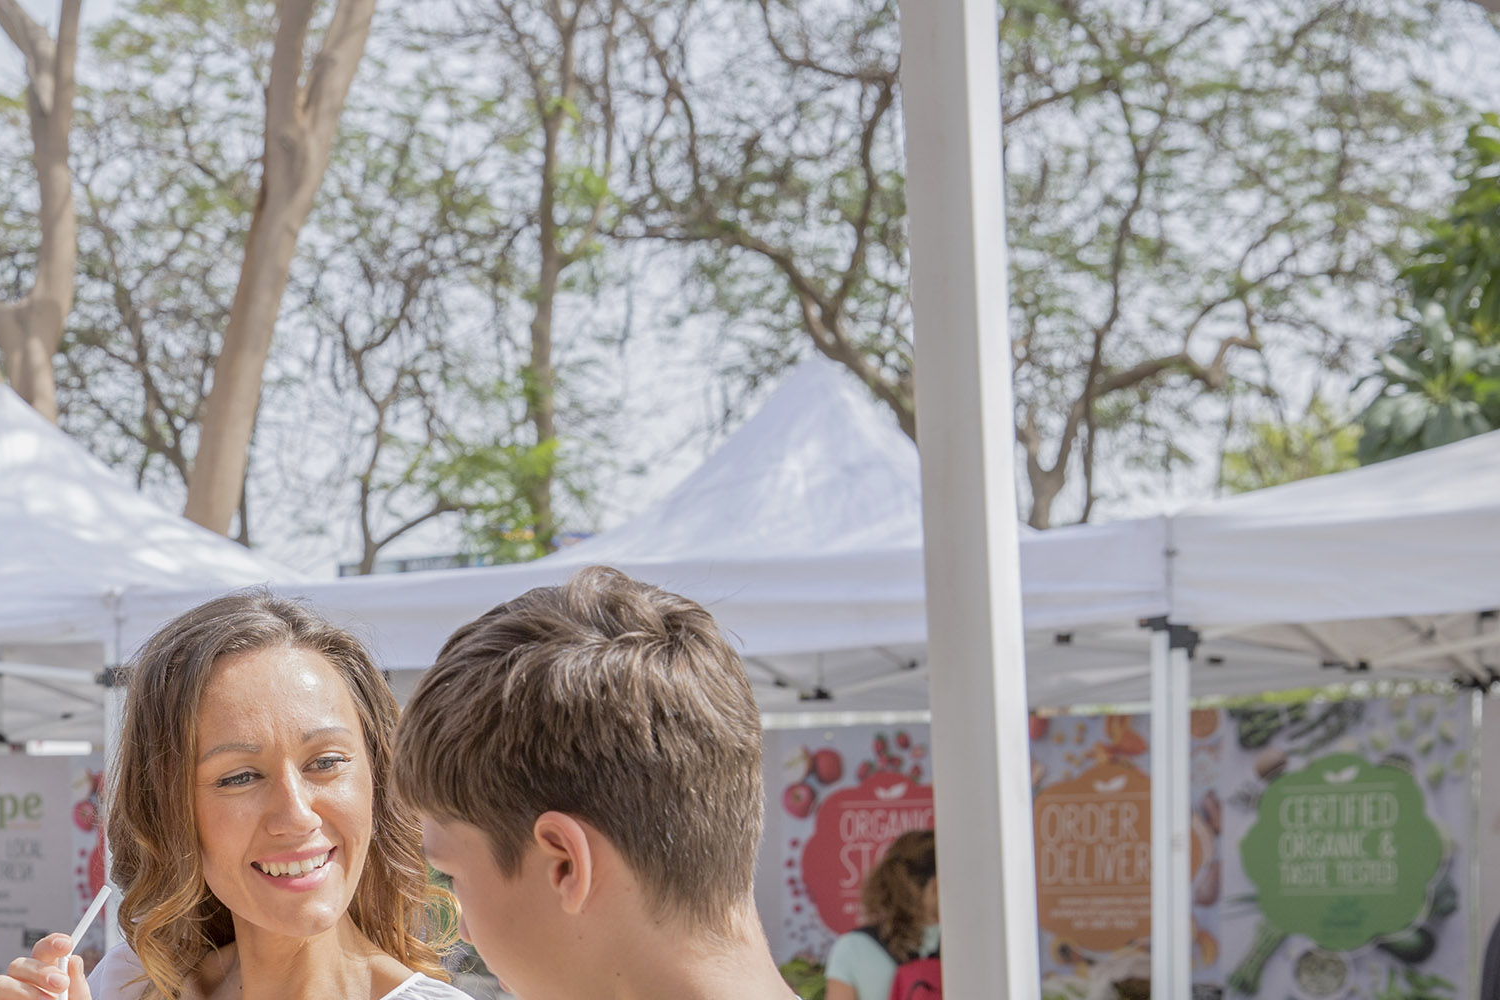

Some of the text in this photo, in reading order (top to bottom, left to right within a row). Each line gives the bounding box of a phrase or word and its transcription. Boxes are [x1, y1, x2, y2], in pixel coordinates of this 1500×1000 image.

[1041, 801, 1140, 845] ORDER
[1279, 792, 1398, 831] CERTIFIED
[1041, 841, 1150, 886] DELIVER
[1378, 830, 1397, 858] &
